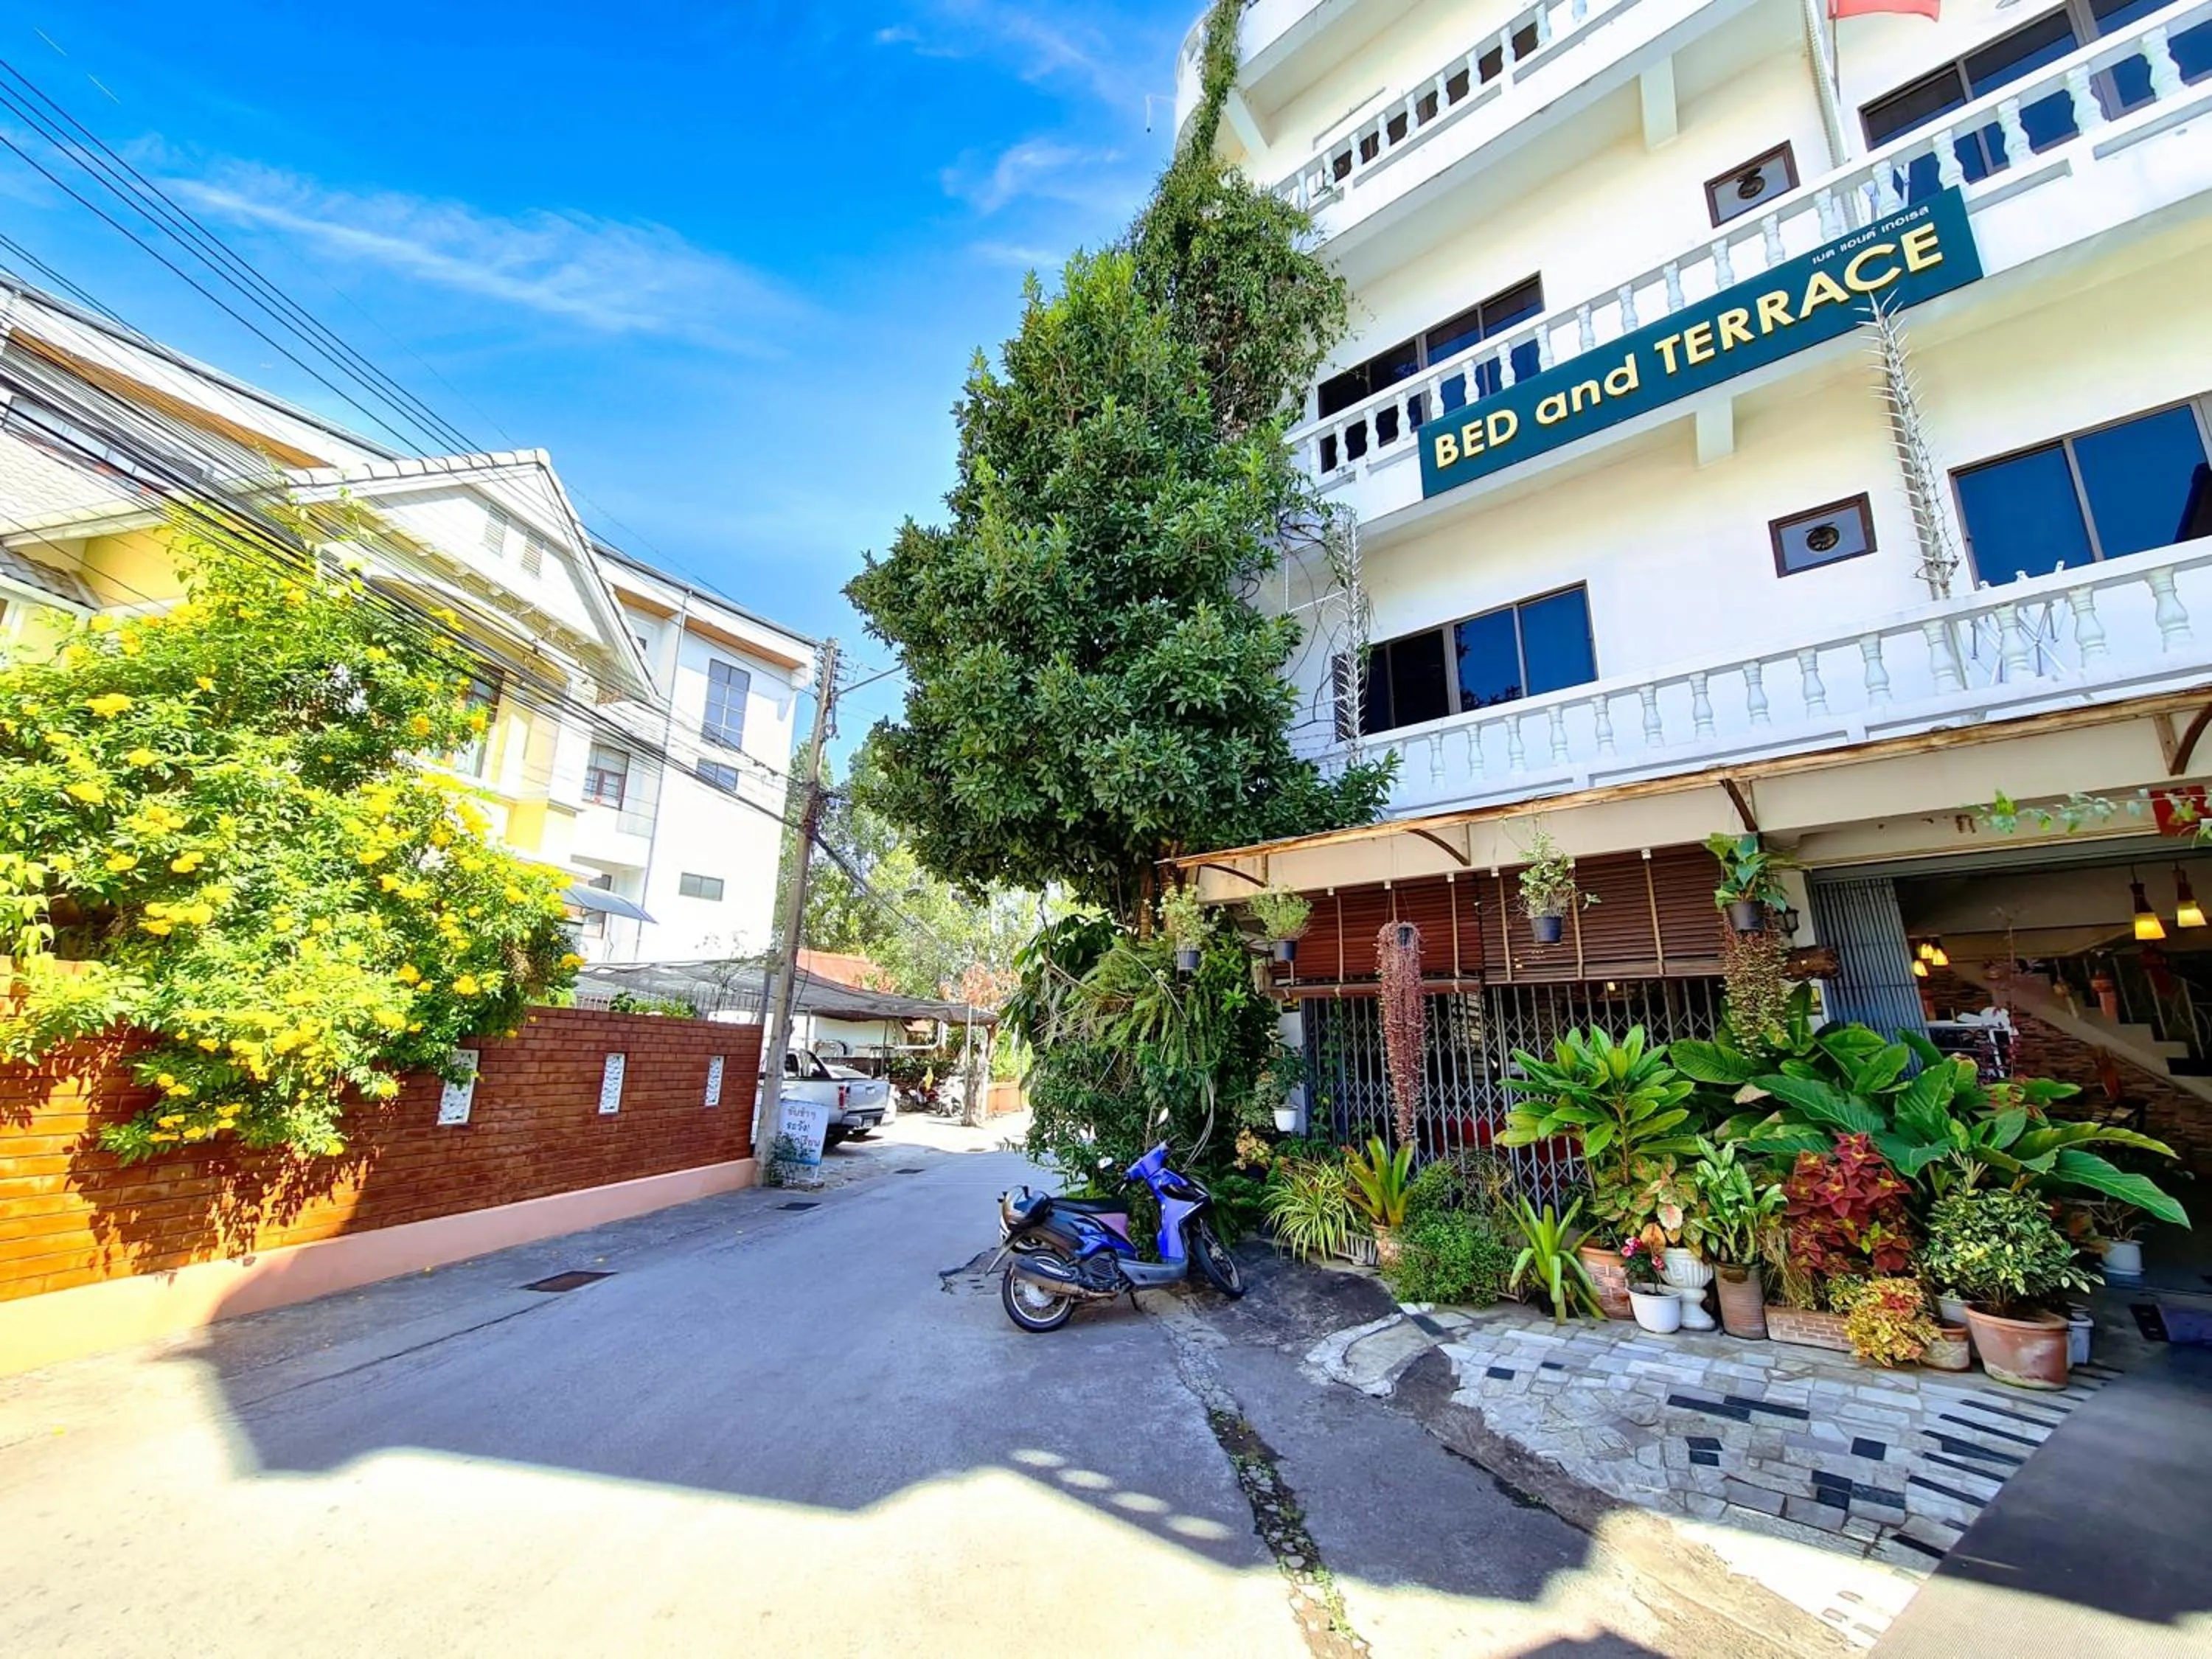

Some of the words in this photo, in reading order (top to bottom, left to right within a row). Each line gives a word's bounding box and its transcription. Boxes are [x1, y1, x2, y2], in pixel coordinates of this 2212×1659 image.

[1435, 410, 1519, 469] BED
[1535, 354, 1640, 425] and
[1654, 222, 1944, 375] TERRACE
